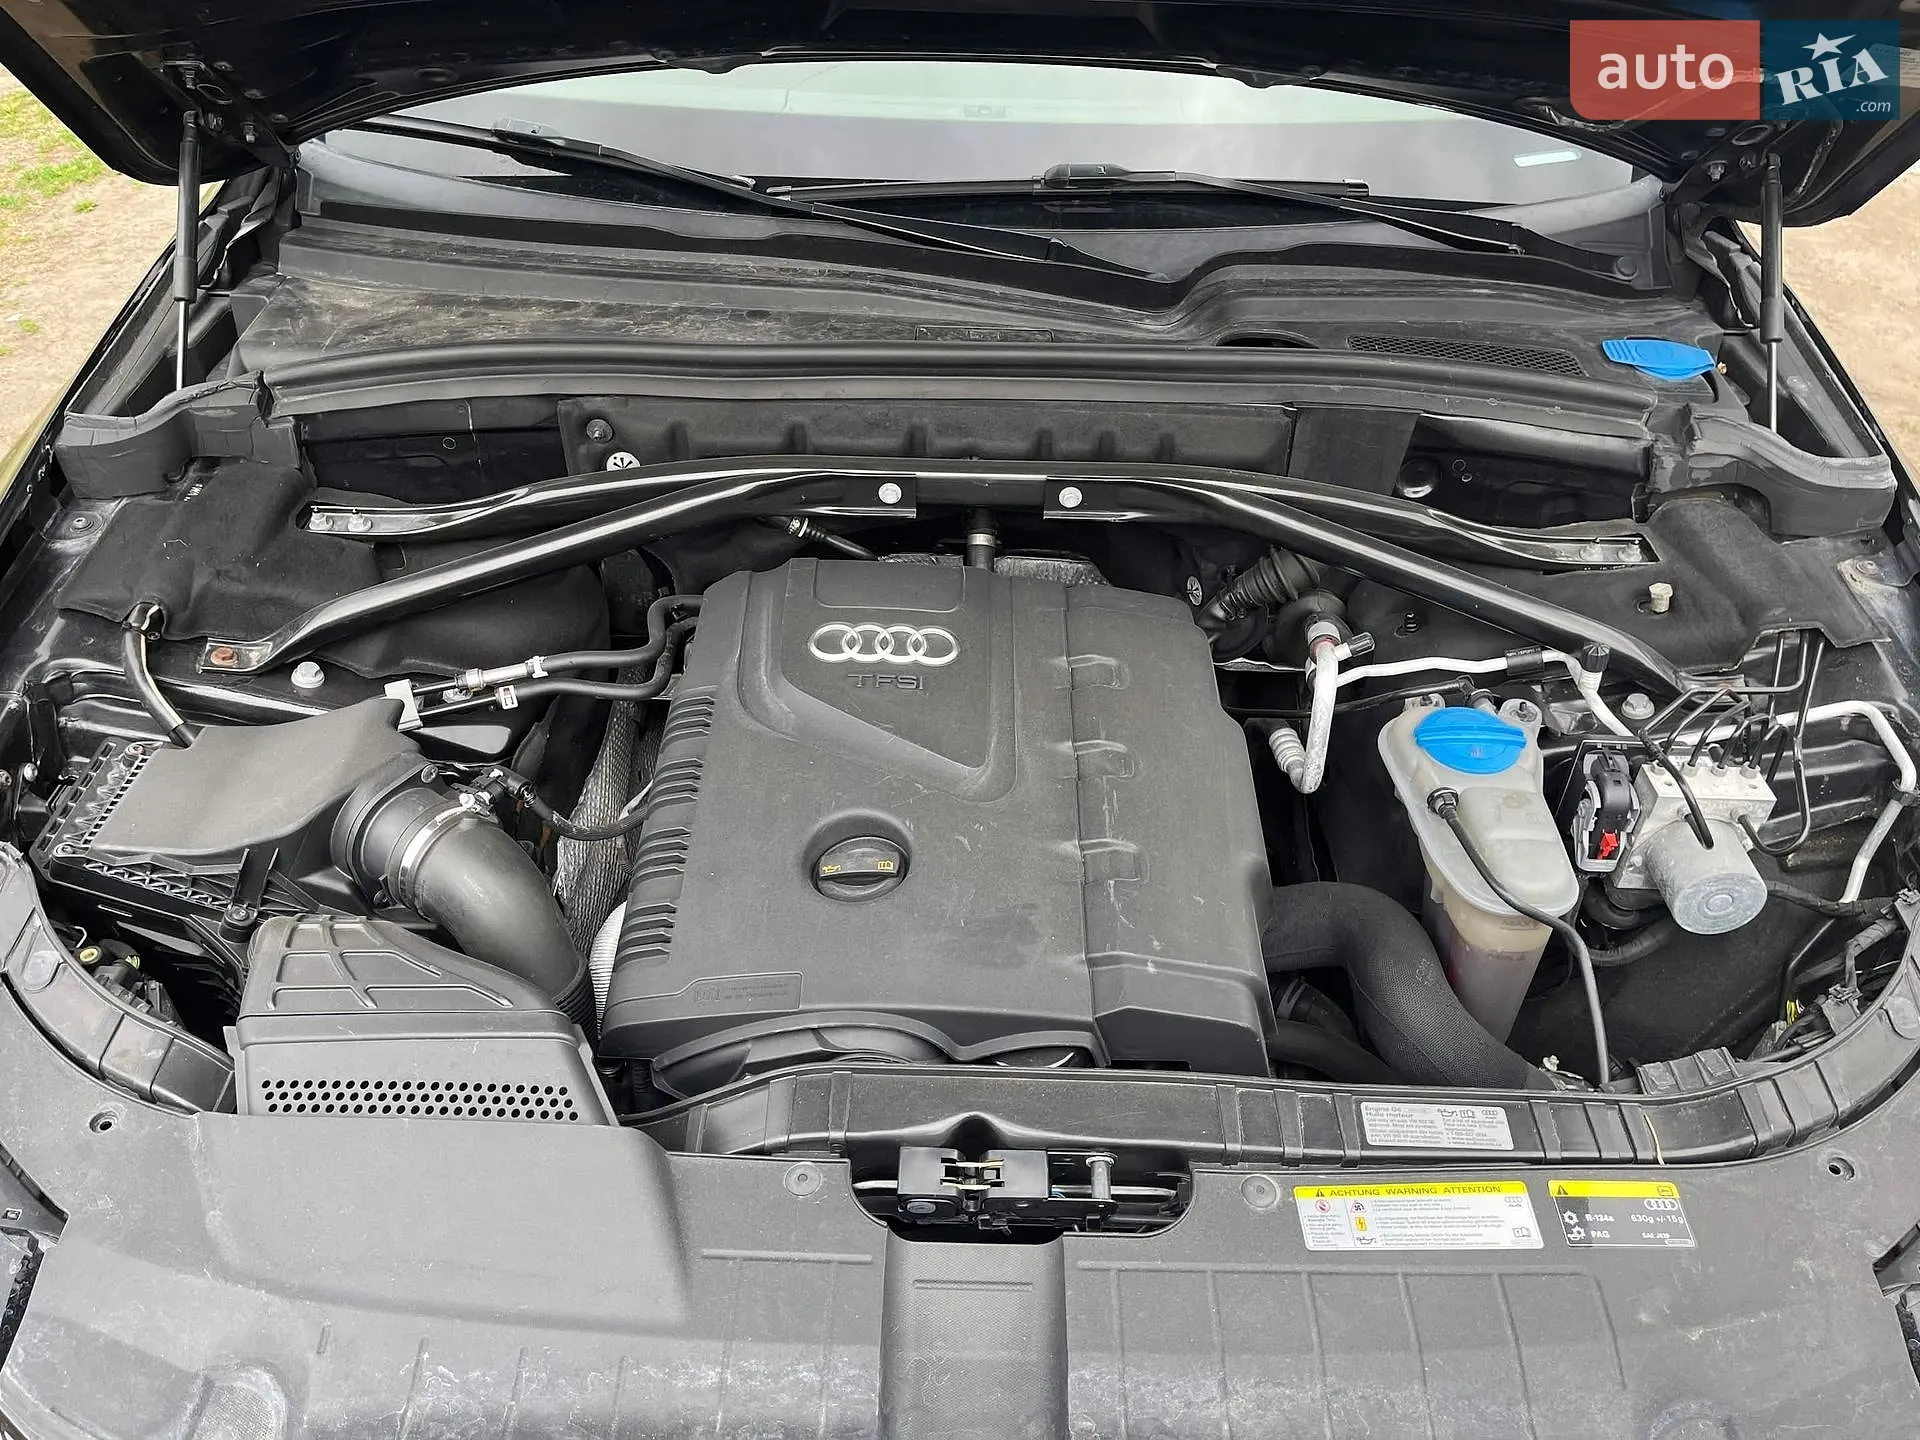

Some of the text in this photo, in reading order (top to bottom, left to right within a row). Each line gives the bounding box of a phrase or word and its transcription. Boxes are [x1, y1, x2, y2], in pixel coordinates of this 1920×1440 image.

[847, 673, 924, 690] TFSI
[1329, 1185, 1501, 1197] ACHTUNG WARNING ATTENTION
[1585, 1213, 1615, 1222] R-134a
[1590, 1230, 1610, 1239] PAG
